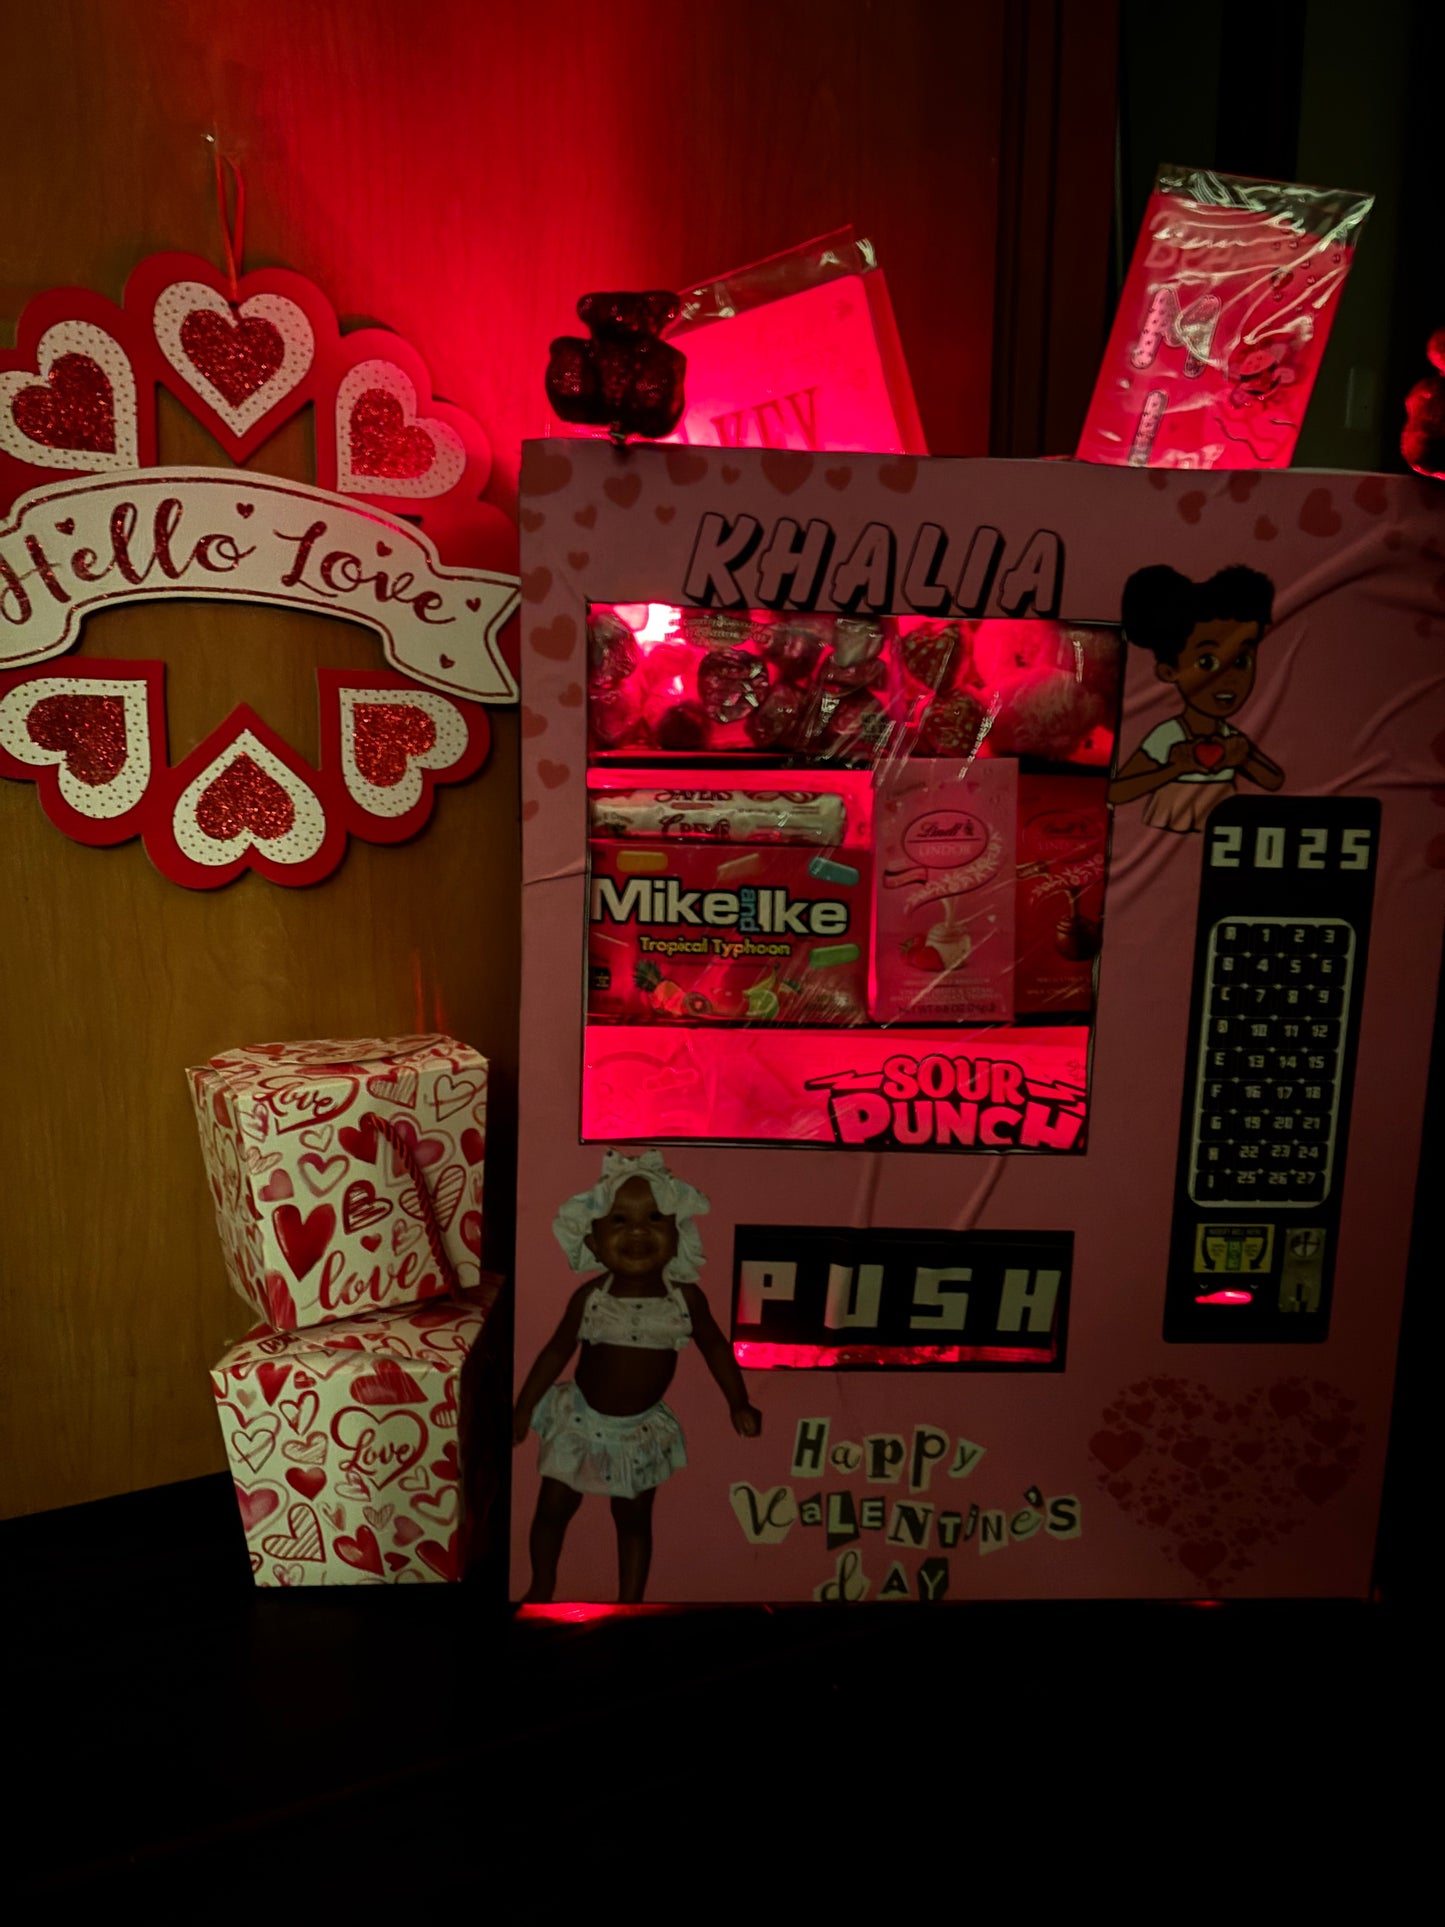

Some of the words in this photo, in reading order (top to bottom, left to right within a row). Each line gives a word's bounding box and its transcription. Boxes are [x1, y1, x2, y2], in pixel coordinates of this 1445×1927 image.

[0, 498, 257, 625] Hello
[273, 520, 456, 624] Love
[682, 511, 1065, 619] KHALIA
[1209, 825, 1373, 871] 2025
[590, 877, 740, 926] Mike
[756, 887, 849, 936] Ike
[639, 936, 708, 957] Tropical
[713, 938, 792, 959] Typhoon
[1262, 928, 1271, 943] 1
[1293, 928, 1305, 943] 2
[1324, 929, 1336, 944] 3
[1256, 958, 1269, 972] 4
[1290, 959, 1301, 974] 5
[1255, 988, 1267, 1003] 7
[1318, 989, 1330, 1004] 9
[1283, 1024, 1299, 1038] 11
[1311, 1024, 1329, 1038] 12
[1214, 1051, 1226, 1066] E
[1247, 1054, 1265, 1069] 13
[1278, 1055, 1297, 1069] 14
[1308, 1055, 1325, 1069] 15
[882, 1054, 1028, 1105] SOUR
[1211, 1083, 1223, 1098] F
[1244, 1085, 1261, 1099] 16
[1276, 1085, 1294, 1100] 17
[1305, 1085, 1322, 1099] 18
[254, 1081, 335, 1119] Love
[830, 1089, 1087, 1150] PUNCH
[1244, 1116, 1262, 1130] 19
[1273, 1116, 1294, 1130] 20
[1302, 1116, 1321, 1130] 21
[1238, 1145, 1259, 1159] 22
[1270, 1144, 1291, 1158] 23
[1297, 1145, 1319, 1159] 24
[1236, 1170, 1257, 1185] 25
[1268, 1171, 1288, 1185] 26
[1298, 1171, 1317, 1185] 27
[302, 1250, 418, 1311] love
[736, 1259, 1064, 1334] PUSH
[338, 1428, 416, 1476] Love
[793, 1420, 979, 1488] Happy
